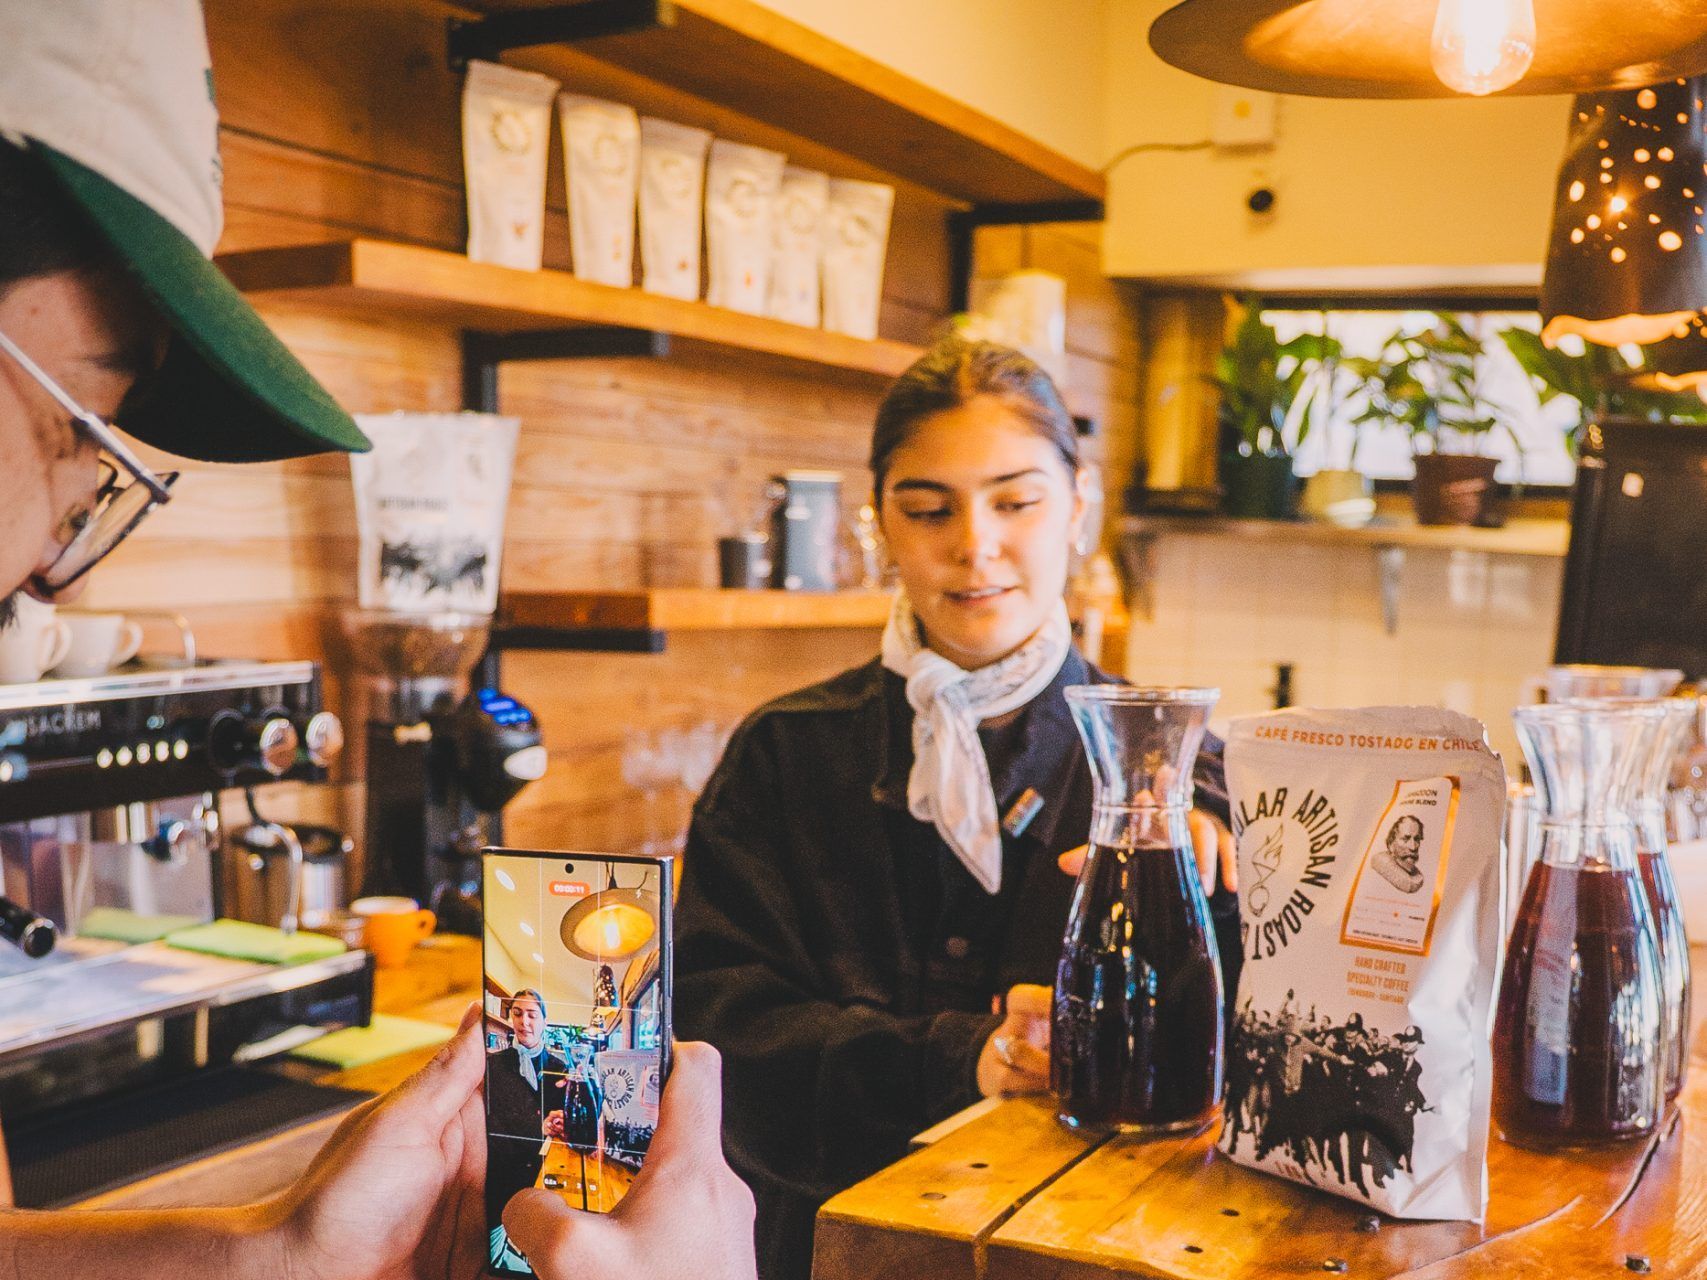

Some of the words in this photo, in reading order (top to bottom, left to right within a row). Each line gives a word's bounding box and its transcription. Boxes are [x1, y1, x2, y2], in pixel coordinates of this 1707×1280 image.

[1255, 726, 1288, 742] CAFÉ
[1291, 729, 1344, 747] FRESCO
[1349, 734, 1413, 750] TOSTADO
[1418, 738, 1438, 750] EN
[1442, 737, 1481, 751] CHILE
[1291, 788, 1339, 889] ARTISAN
[1383, 977, 1410, 993] COFFEE
